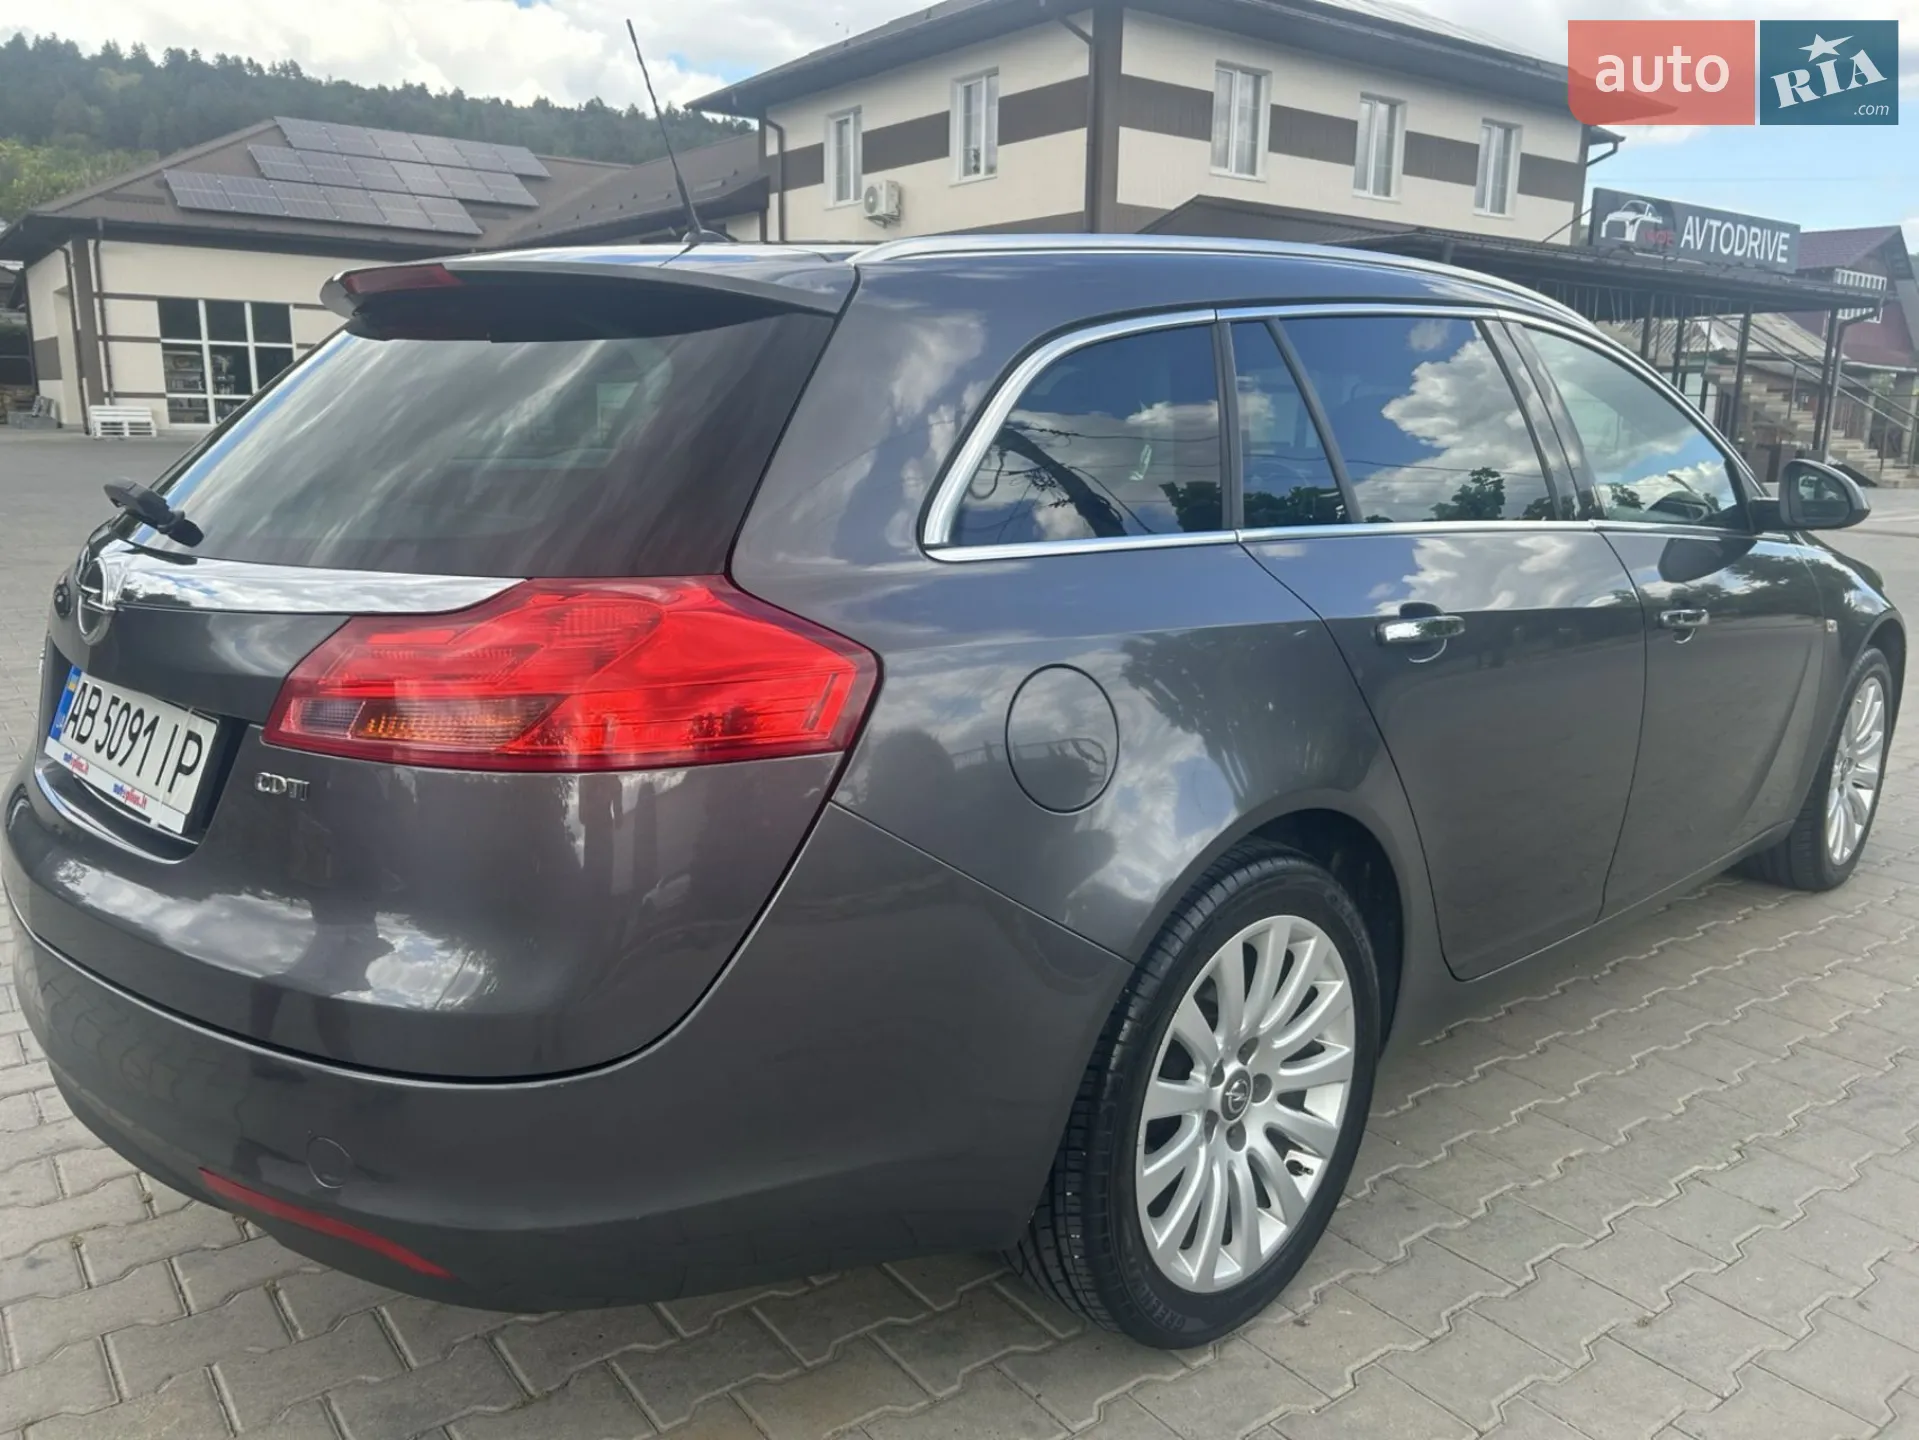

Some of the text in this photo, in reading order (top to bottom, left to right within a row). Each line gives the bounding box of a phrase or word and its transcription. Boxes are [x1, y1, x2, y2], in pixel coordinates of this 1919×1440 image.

[1681, 215, 1790, 264] AVTODRIVE
[63, 682, 203, 793] AB 5091 IP
